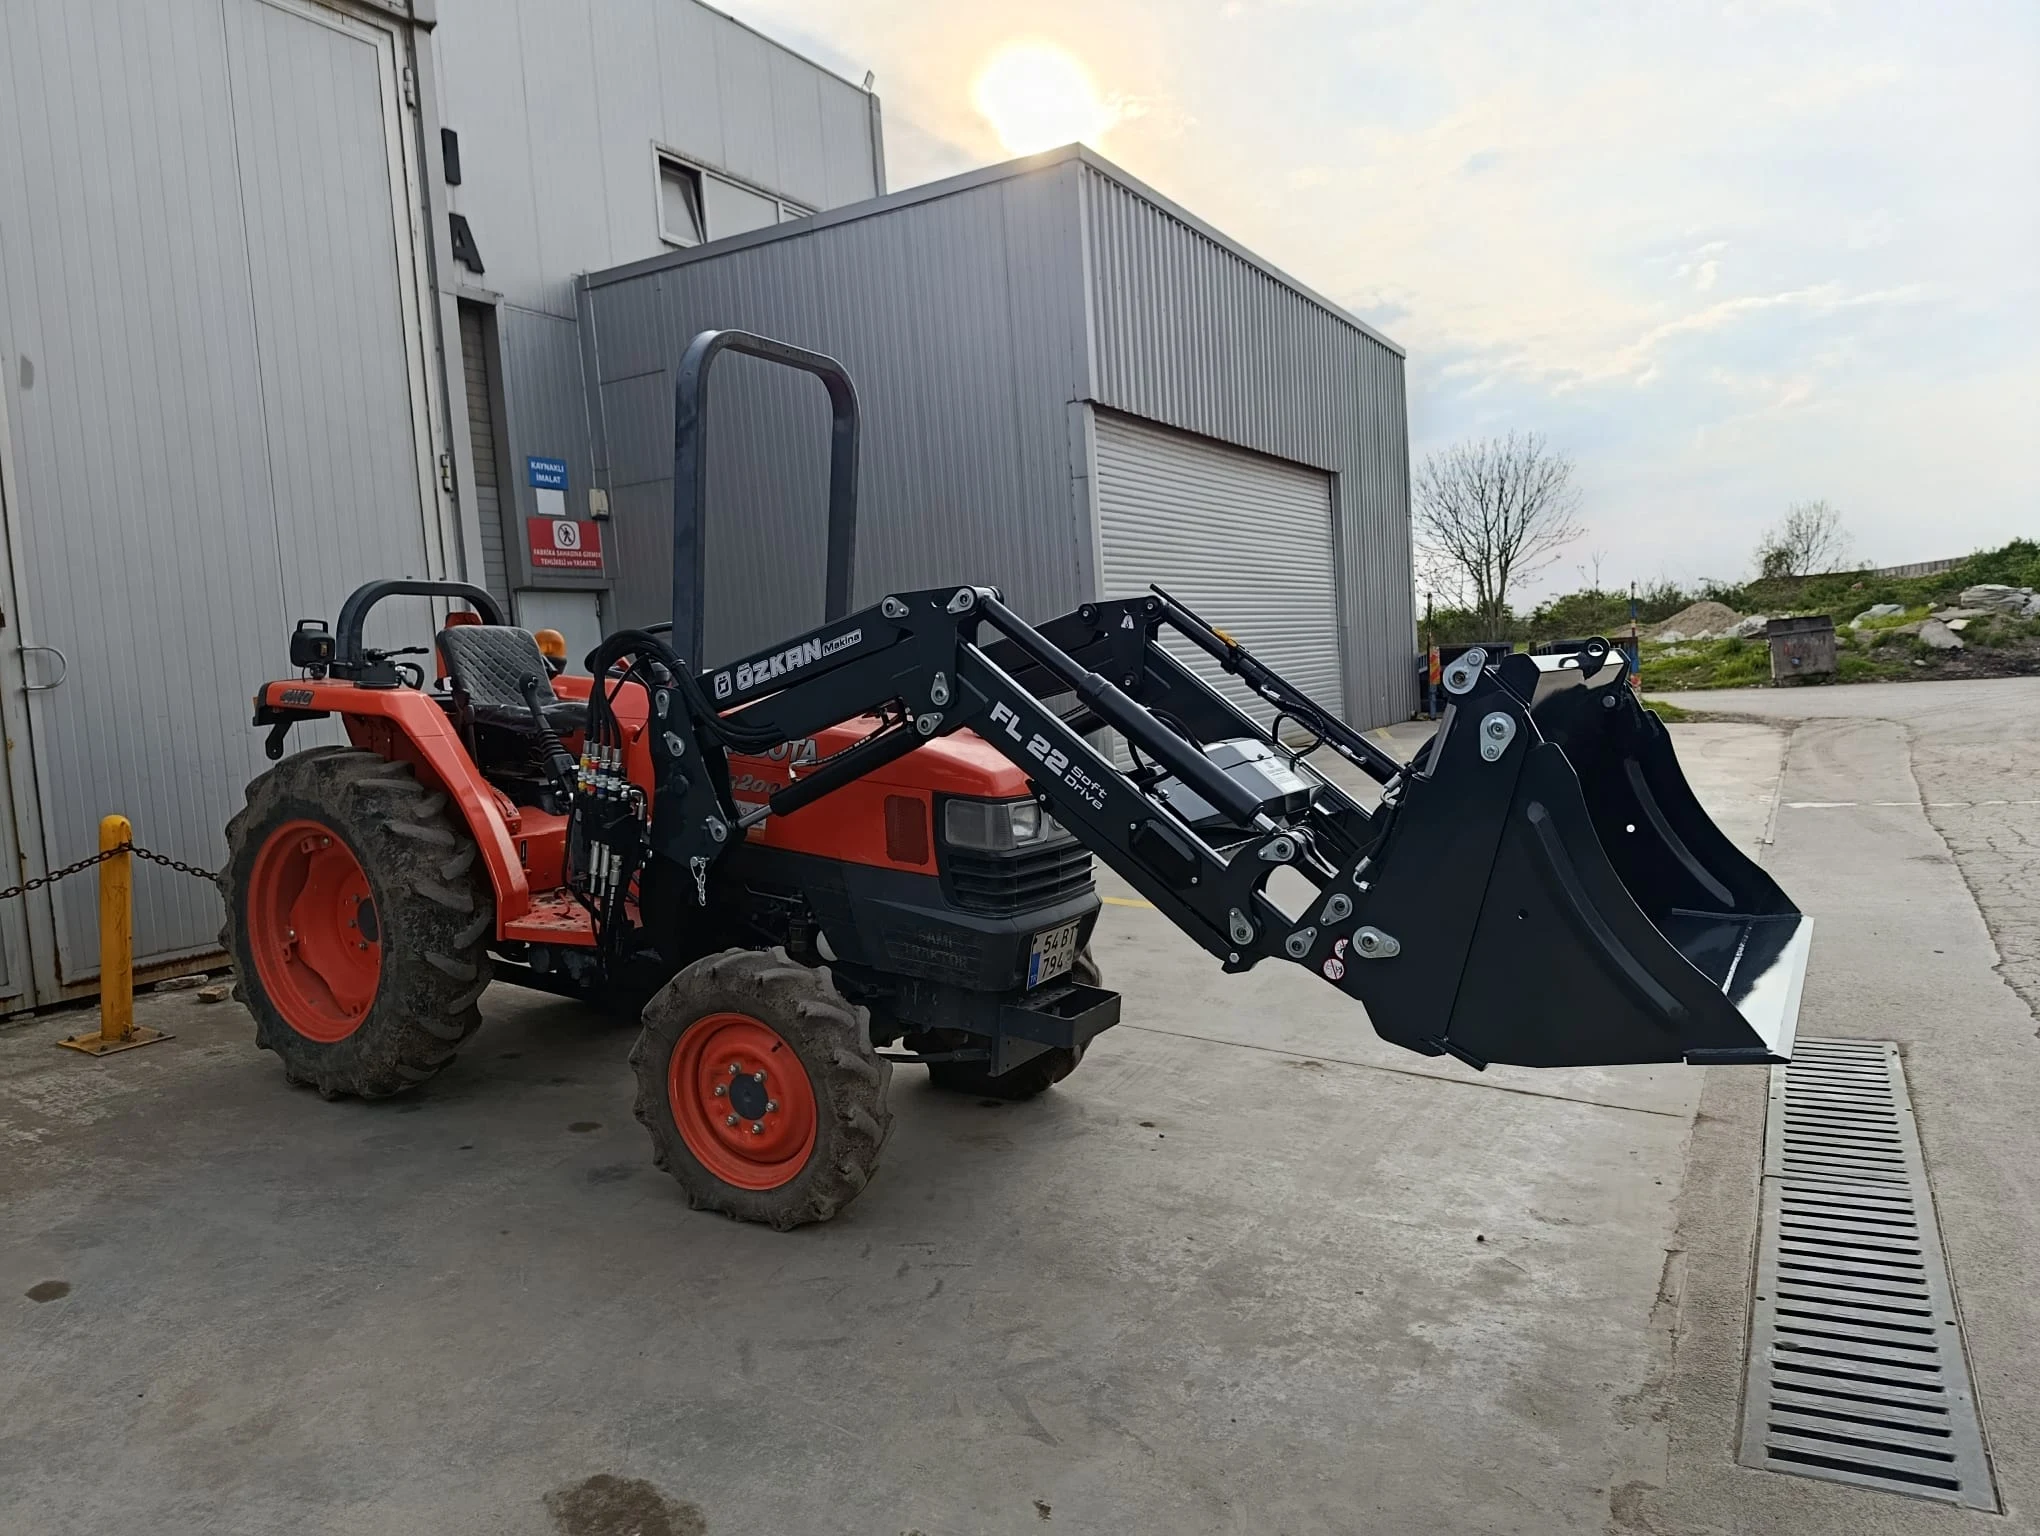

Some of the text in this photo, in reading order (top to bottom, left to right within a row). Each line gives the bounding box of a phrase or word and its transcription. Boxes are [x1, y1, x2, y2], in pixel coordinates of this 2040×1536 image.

[530, 461, 564, 472] KAYNAKLI
[736, 637, 822, 691] ÖZKAN
[824, 633, 861, 654] Makina
[990, 701, 1107, 799] FL 22 Soft
[1064, 774, 1103, 810] Drive
[1043, 931, 1059, 954] 54
[1042, 952, 1063, 979] 794
